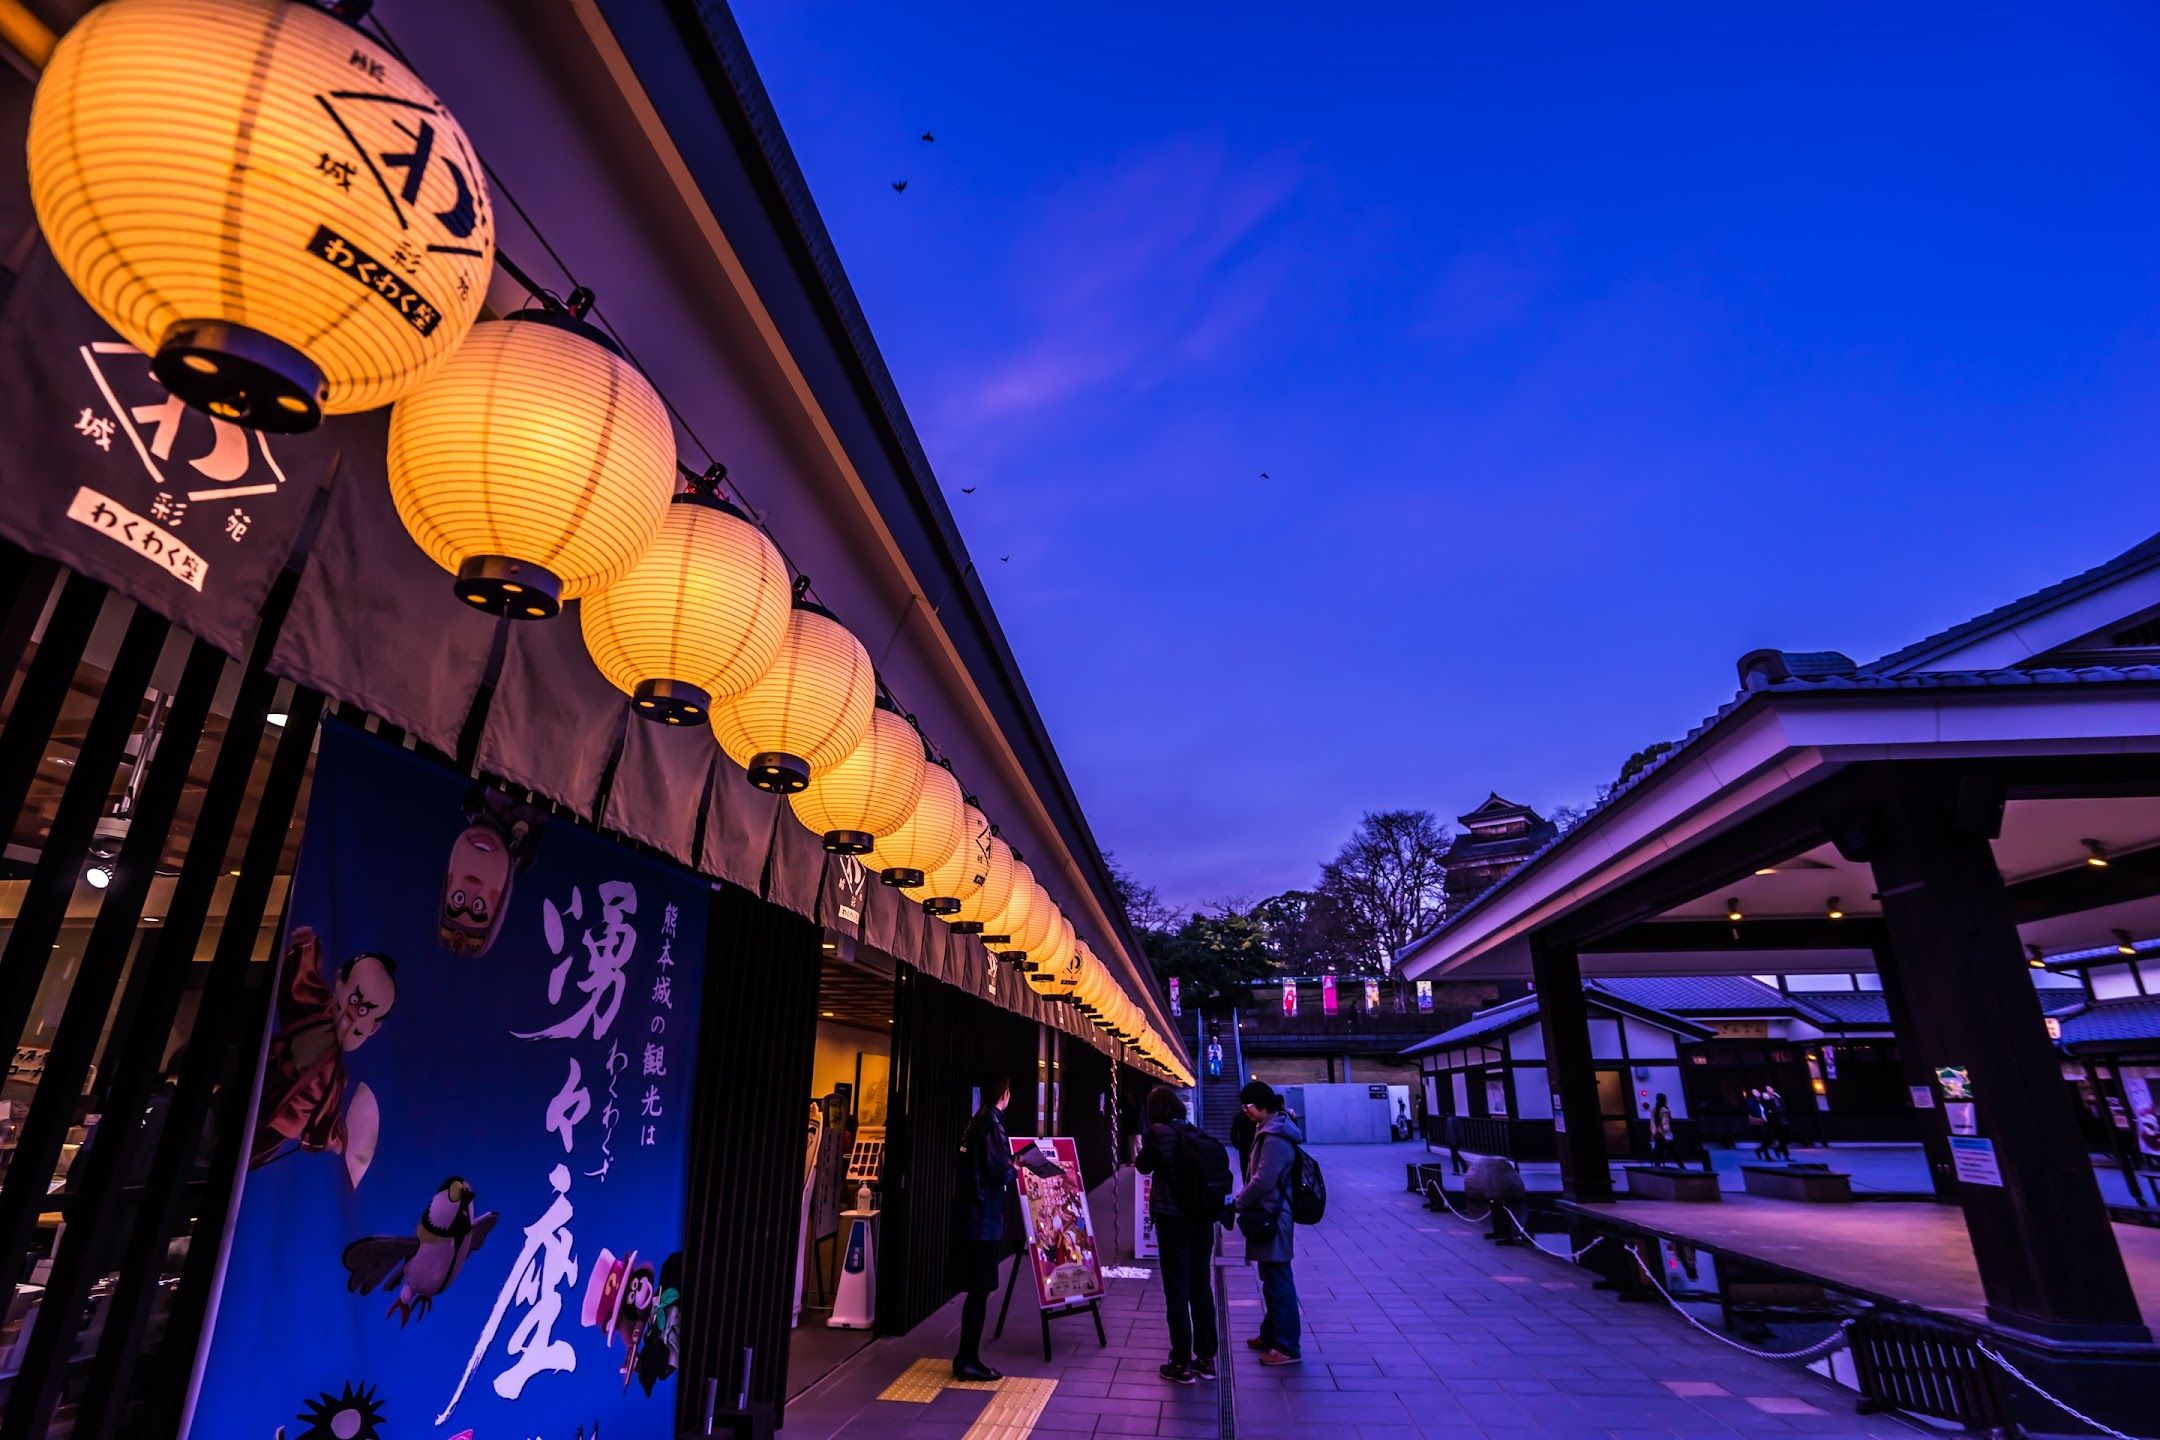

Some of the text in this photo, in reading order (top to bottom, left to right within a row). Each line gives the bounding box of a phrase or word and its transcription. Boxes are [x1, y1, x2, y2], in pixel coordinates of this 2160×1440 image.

[381, 118, 476, 238] わ
[324, 238, 437, 331] わくわく座
[90, 502, 201, 583] わくわく座
[640, 902, 680, 1147] 熊本城の観光は
